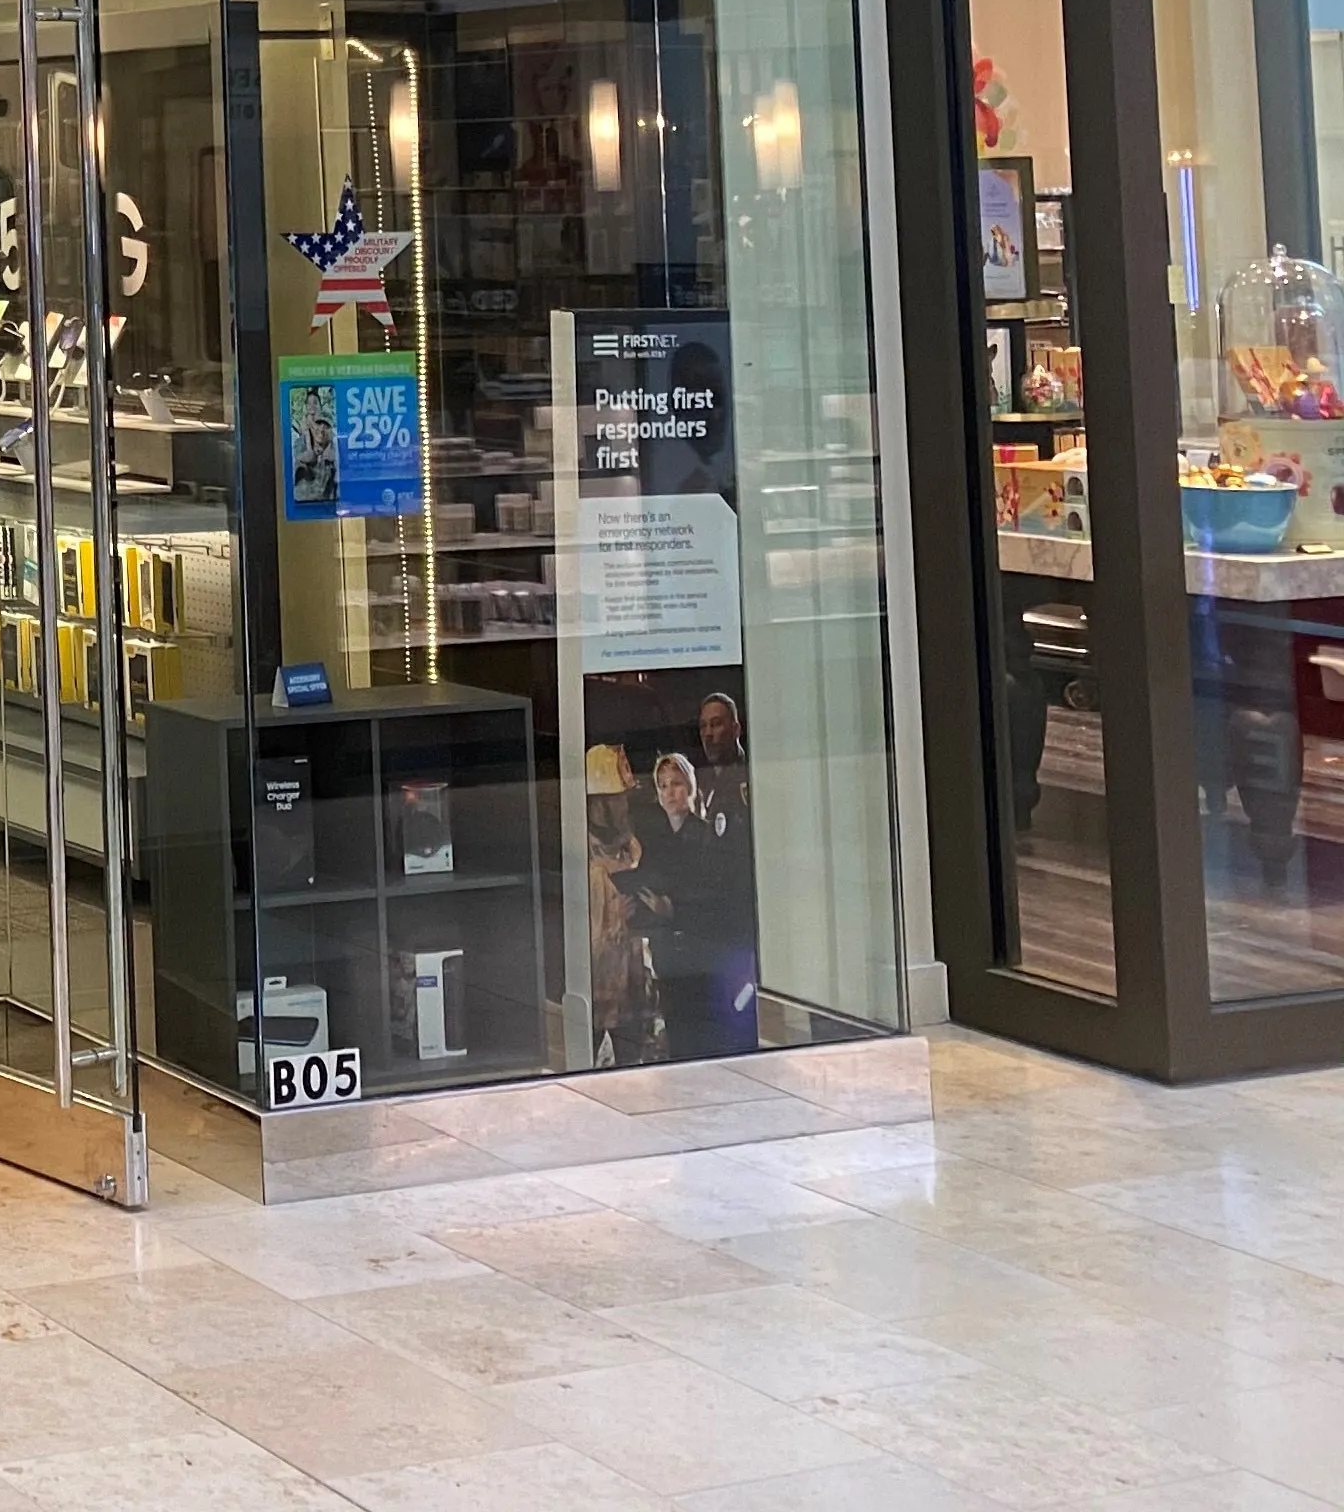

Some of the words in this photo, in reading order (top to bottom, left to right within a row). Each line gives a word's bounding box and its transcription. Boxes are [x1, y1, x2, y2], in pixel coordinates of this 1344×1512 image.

[347, 385, 407, 416] SAVE
[595, 388, 668, 414] Putting
[673, 387, 713, 409] first
[348, 415, 411, 450] 25%
[596, 415, 707, 443] responders
[596, 446, 639, 469] first
[598, 512, 621, 524] Now
[658, 513, 671, 523] an
[654, 524, 694, 536] network
[273, 1053, 358, 1105] B05
